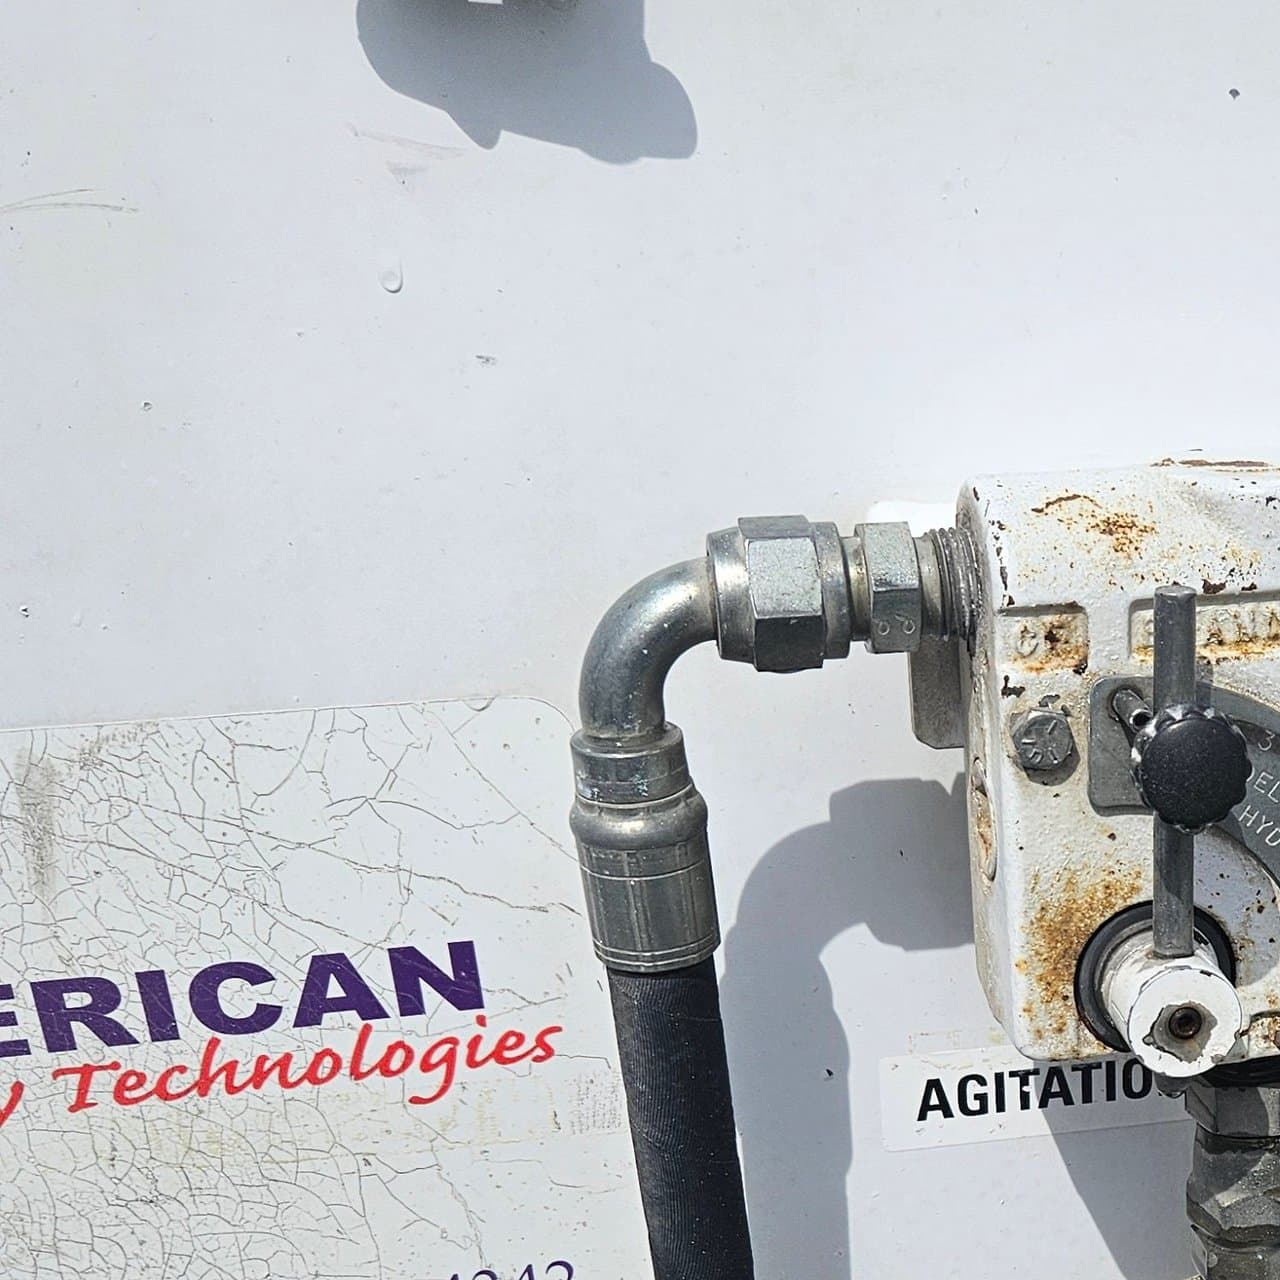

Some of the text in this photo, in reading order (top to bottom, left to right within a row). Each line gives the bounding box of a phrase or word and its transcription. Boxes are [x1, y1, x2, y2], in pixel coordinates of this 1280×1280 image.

[1257, 730, 1275, 751] 3
[52, 1015, 563, 1113] Technologies
[917, 1056, 1164, 1122] AGITATIO
